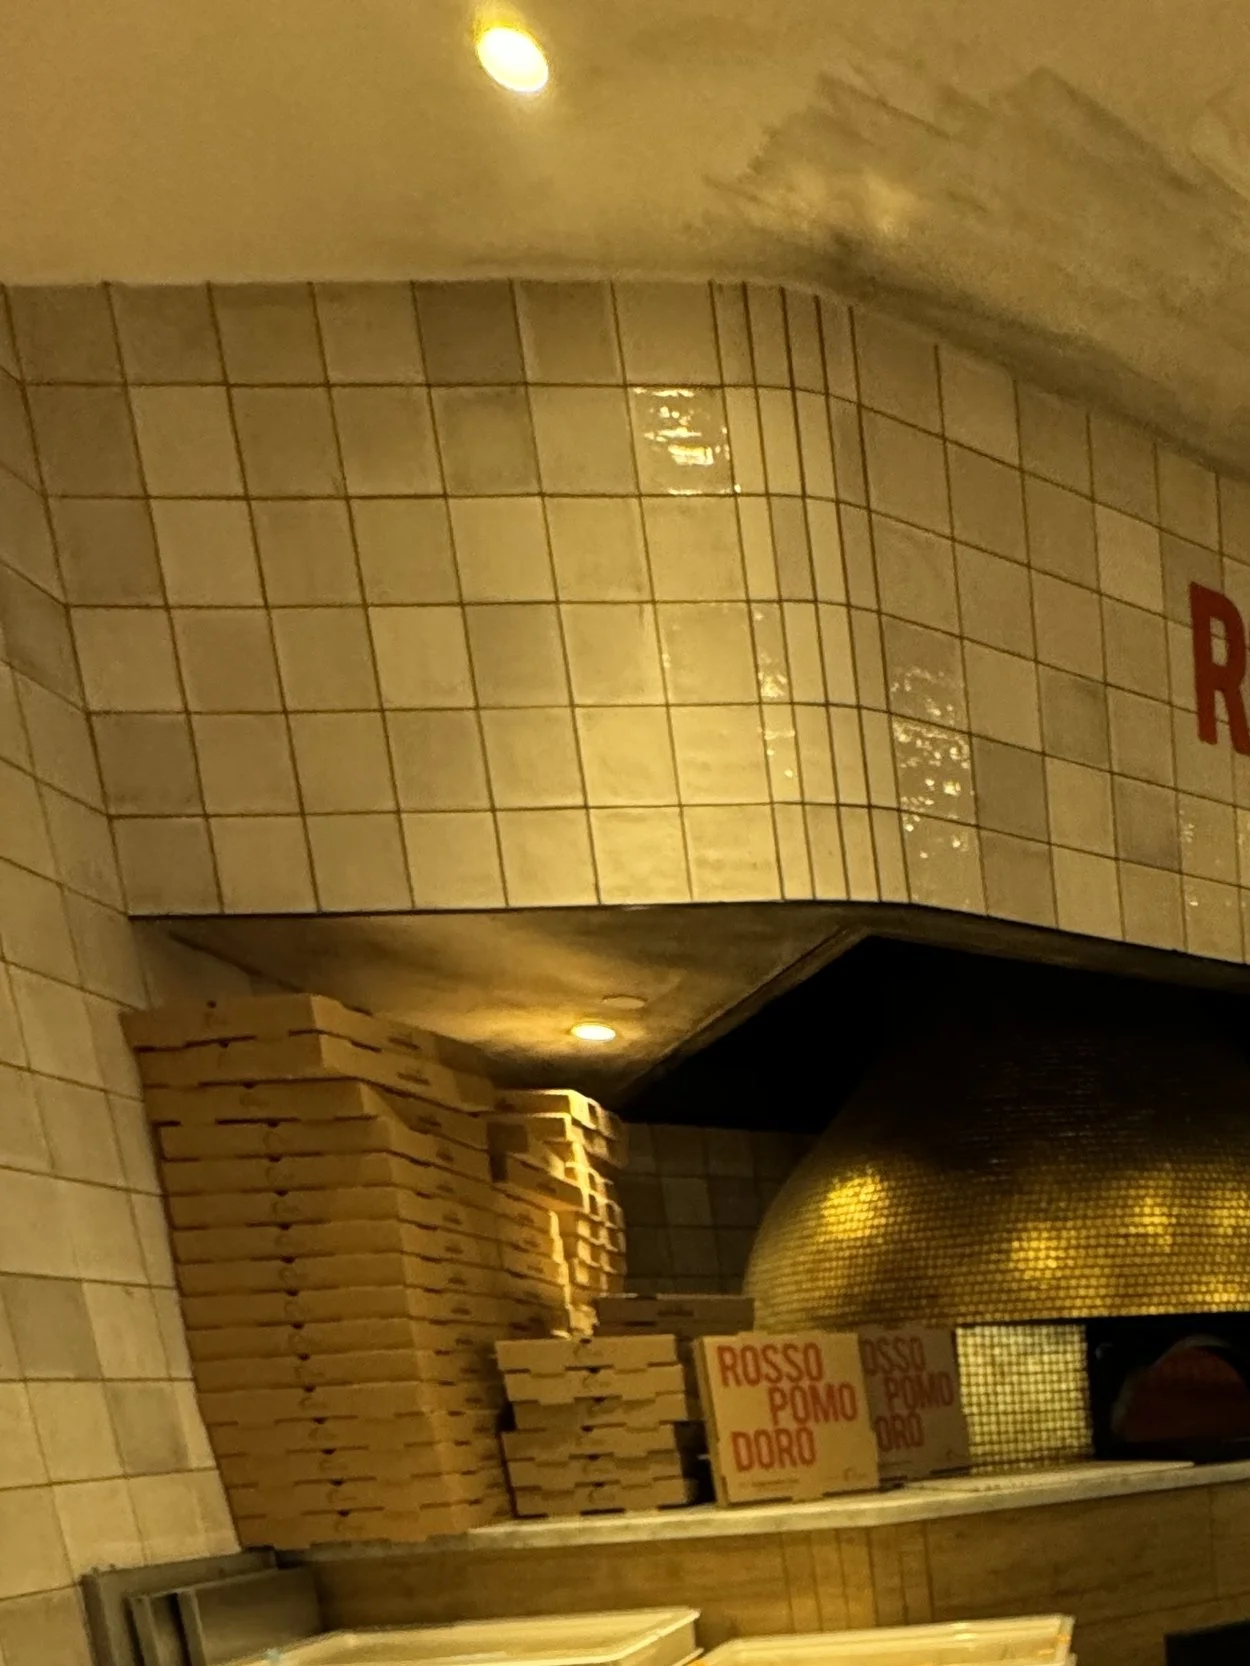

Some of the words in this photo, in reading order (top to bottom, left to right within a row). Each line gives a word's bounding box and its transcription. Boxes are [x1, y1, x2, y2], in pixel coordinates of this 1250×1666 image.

[716, 1341, 824, 1388] ROSSO
[767, 1382, 859, 1427] POMO
[884, 1371, 955, 1414] POMO
[731, 1426, 818, 1473] DORO
